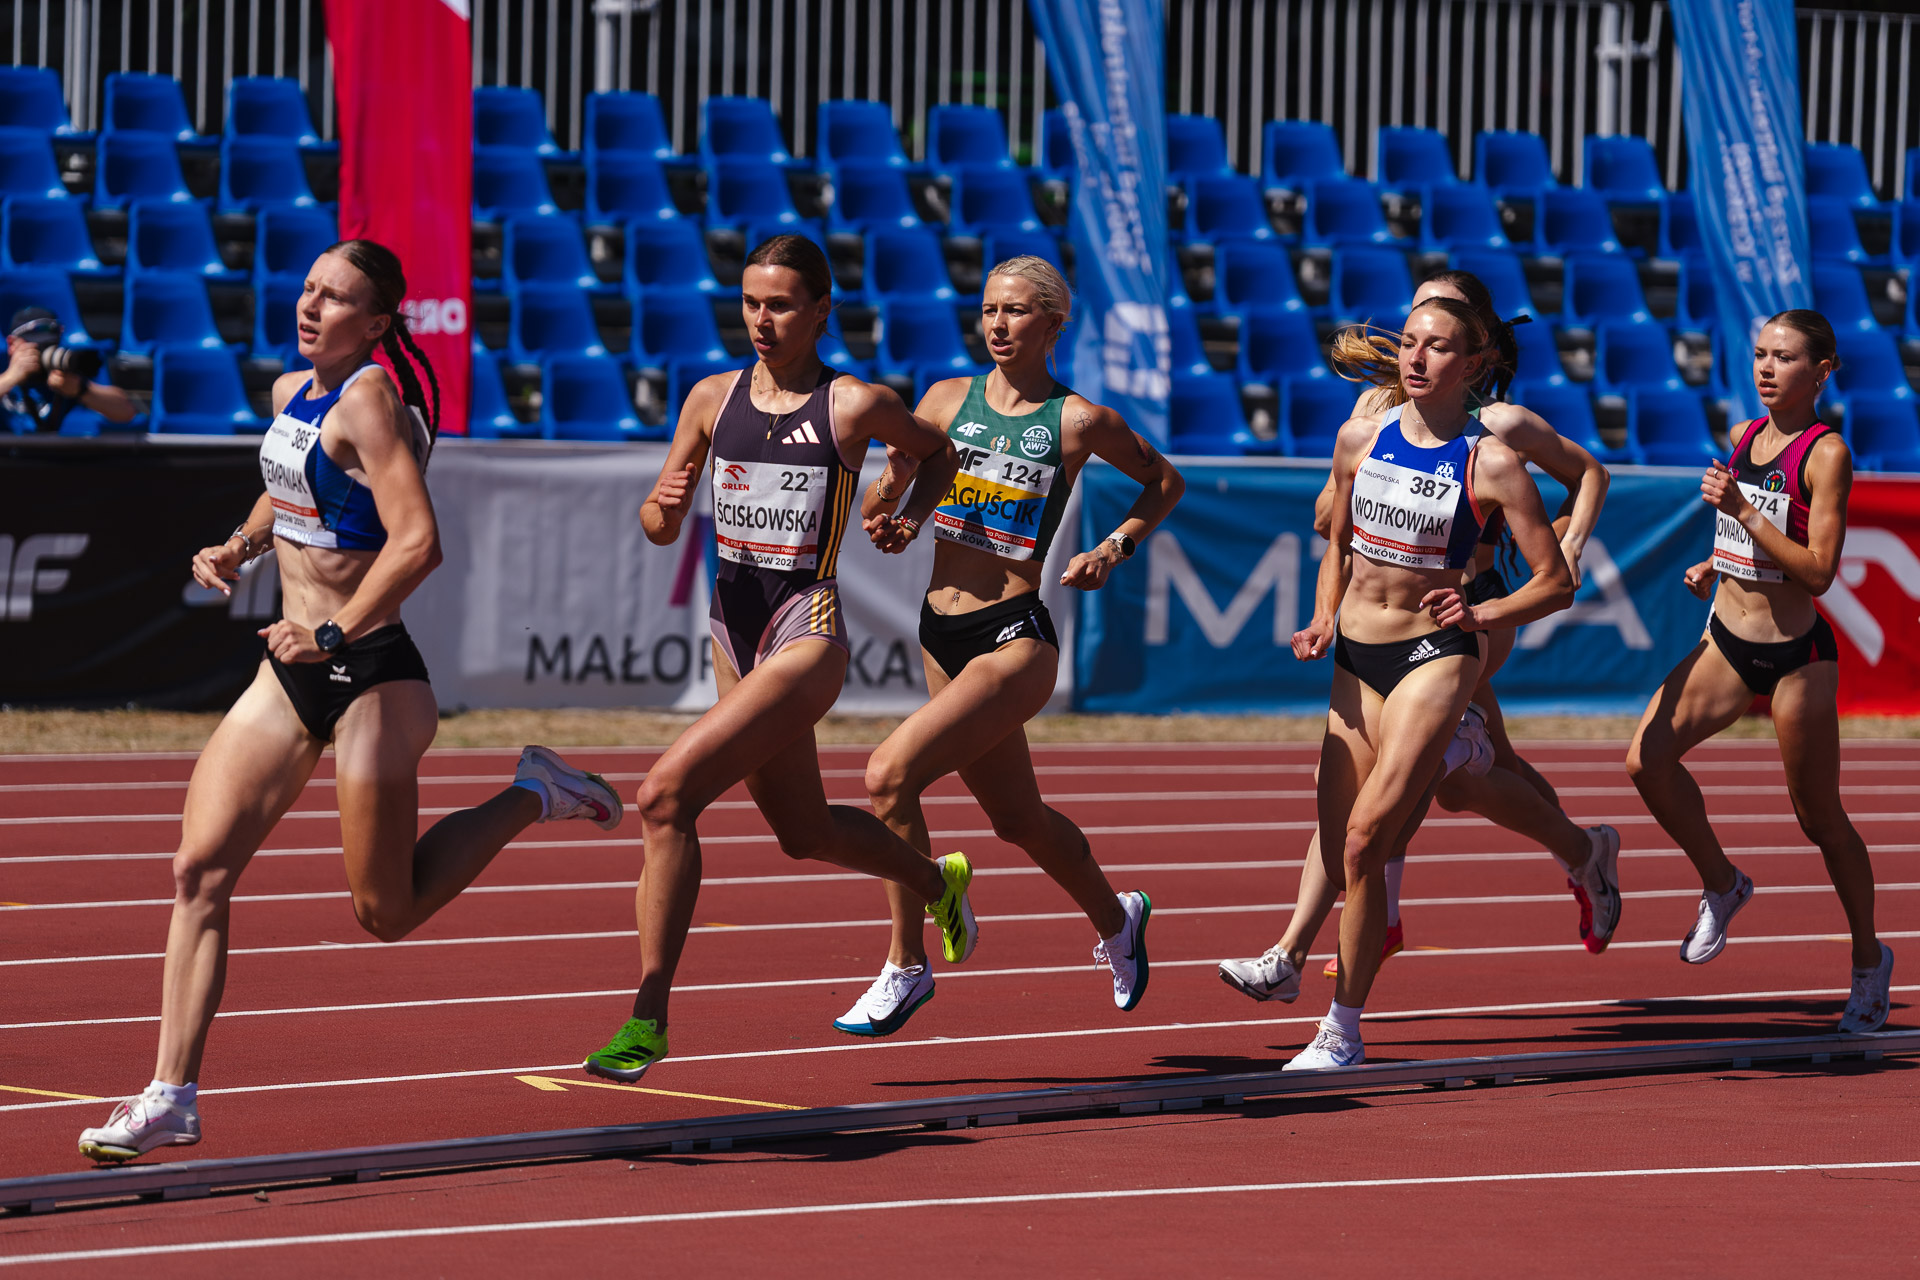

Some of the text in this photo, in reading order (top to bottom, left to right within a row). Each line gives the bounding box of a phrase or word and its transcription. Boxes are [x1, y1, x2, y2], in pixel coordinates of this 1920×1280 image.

[291, 427, 311, 451] 385
[956, 421, 988, 438] 4F
[1028, 429, 1047, 439] AZS
[1024, 441, 1048, 452] AWF
[780, 471, 809, 492] 22
[1002, 461, 1043, 488] 124
[721, 483, 750, 491] ORLEN
[1409, 476, 1452, 500] 387
[717, 497, 817, 533] ŚCISŁOWSKA
[943, 483, 1039, 526] AGUŚCIK
[1750, 493, 1778, 515] 274
[1355, 495, 1448, 537] WOJTKOWIAK
[942, 528, 1011, 554] KRAKÓW 2025
[944, 517, 959, 527] PZLA
[994, 530, 1013, 543] Polski
[1013, 537, 1025, 545] U23
[743, 543, 780, 553] Mistrzostwa
[781, 546, 799, 554] Polski
[1360, 542, 1424, 565] KRAKÓW 2025
[1370, 536, 1406, 550] Mistrzostwa
[1406, 545, 1424, 554] Polski
[732, 552, 798, 567] KRAKÓW 2025
[1716, 560, 1741, 574] KRAKÓW
[0, 533, 90, 622] F
[995, 620, 1025, 643] 4F
[1408, 648, 1441, 662] adidas
[329, 673, 352, 683] erima
